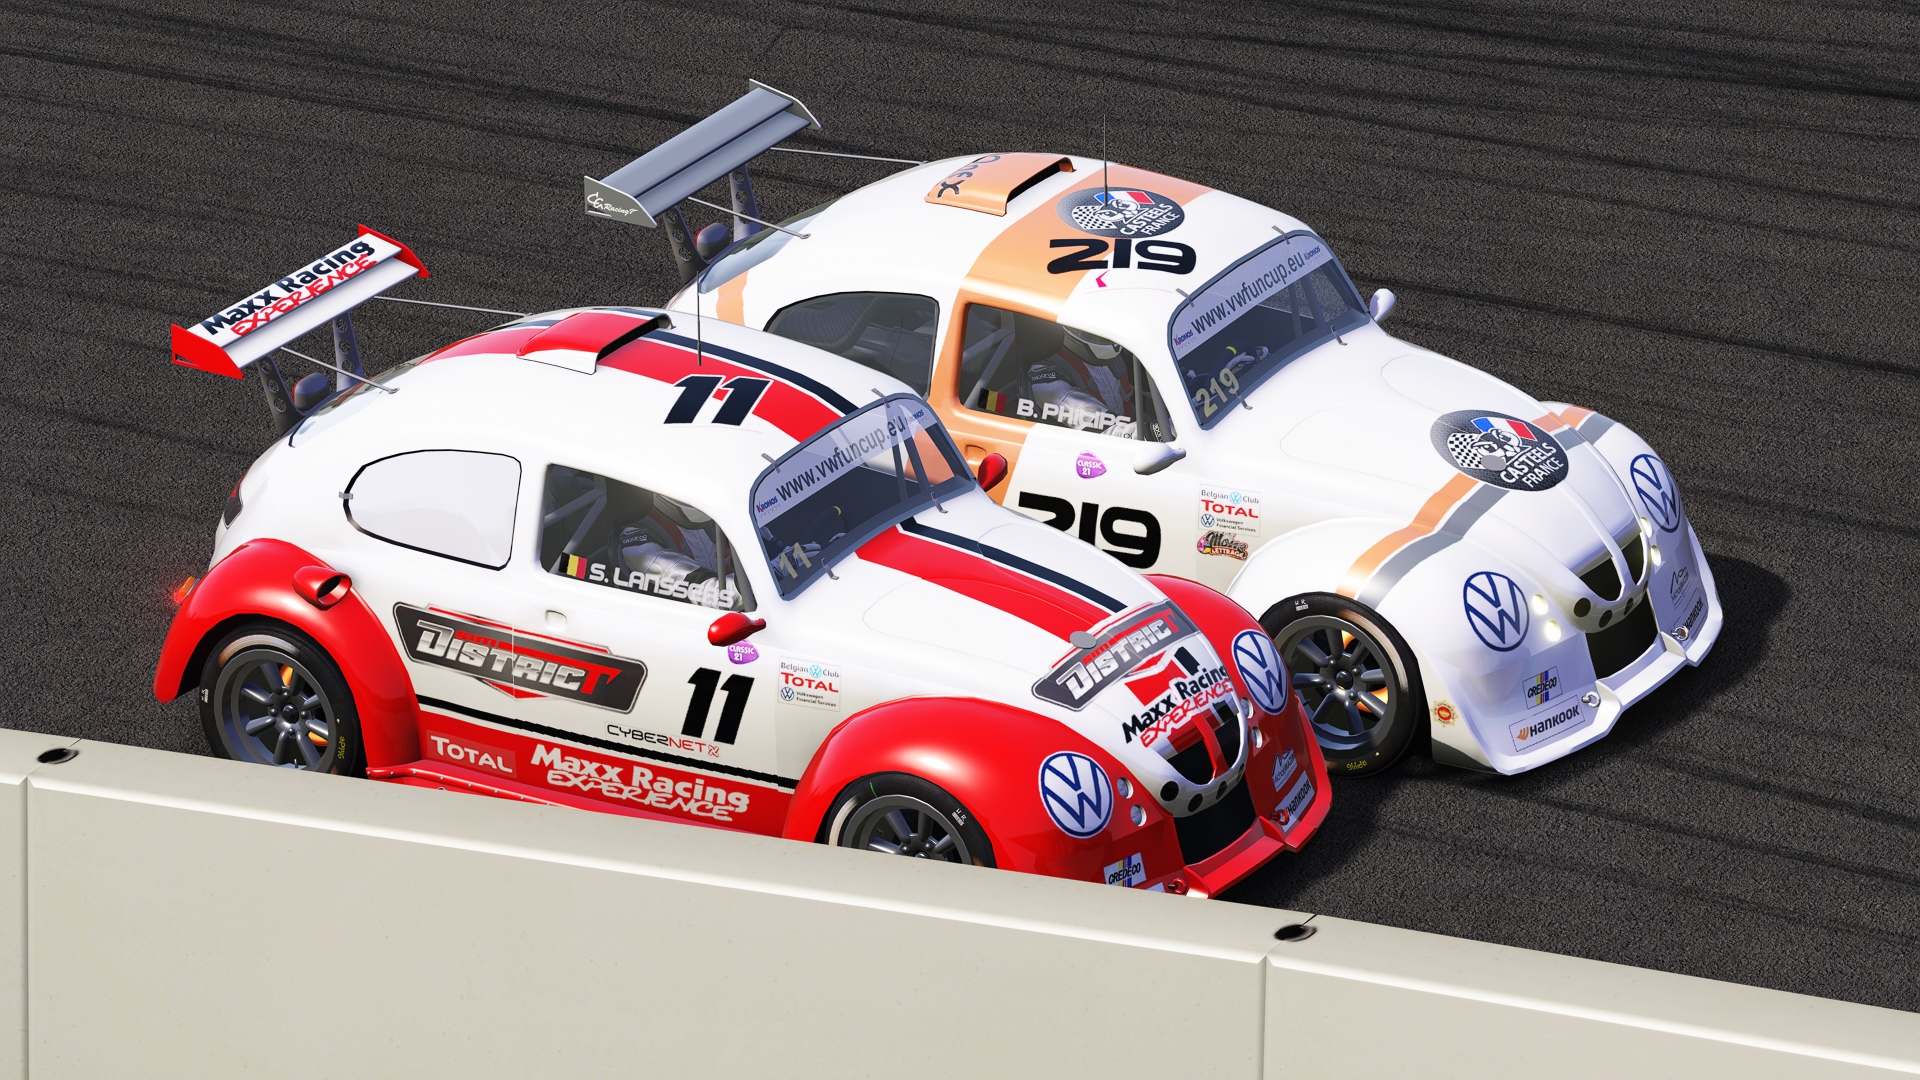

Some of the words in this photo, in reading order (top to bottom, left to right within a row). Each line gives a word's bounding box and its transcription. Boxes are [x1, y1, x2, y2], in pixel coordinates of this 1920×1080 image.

[1120, 203, 1173, 235] CASTEELS
[1141, 212, 1180, 235] FRANCE
[1047, 238, 1196, 274] 219
[200, 289, 280, 335] Maxx
[275, 240, 375, 294] Racing
[231, 254, 377, 336] EXPERIENCE
[1191, 252, 1305, 334] www.vwfuncup.eu
[664, 375, 773, 426] 11
[1017, 398, 1038, 418] B.
[1196, 368, 1239, 417] 219
[776, 415, 906, 502] www.vwfuncup.eu
[1078, 460, 1102, 469] CLASSIC
[1082, 467, 1091, 476] 21
[1500, 442, 1556, 483] CASTEELS
[1521, 457, 1564, 488] FRANCE
[1201, 489, 1228, 499] Belgian
[1242, 495, 1259, 504] Club
[1201, 499, 1259, 518] TOTAL
[589, 563, 609, 583] S.
[778, 542, 812, 579] 11
[416, 619, 622, 695] DISTRICT
[729, 645, 755, 655] CLASSIC
[734, 652, 743, 661] 21
[1056, 608, 1179, 700] DISTRICT
[781, 662, 808, 672] Belgian
[823, 669, 839, 678] Club
[781, 671, 839, 693] TOTAL
[1527, 676, 1558, 698] CREDECO
[681, 667, 755, 745] 11
[1122, 694, 1177, 743] Maxx
[1140, 678, 1233, 748] EXPERIENCE
[430, 735, 513, 773] TOTAL
[530, 744, 623, 783] Maxx
[632, 766, 750, 812] Racing
[546, 769, 733, 822] EXPERIENCE
[1108, 862, 1142, 885] CREDECO
